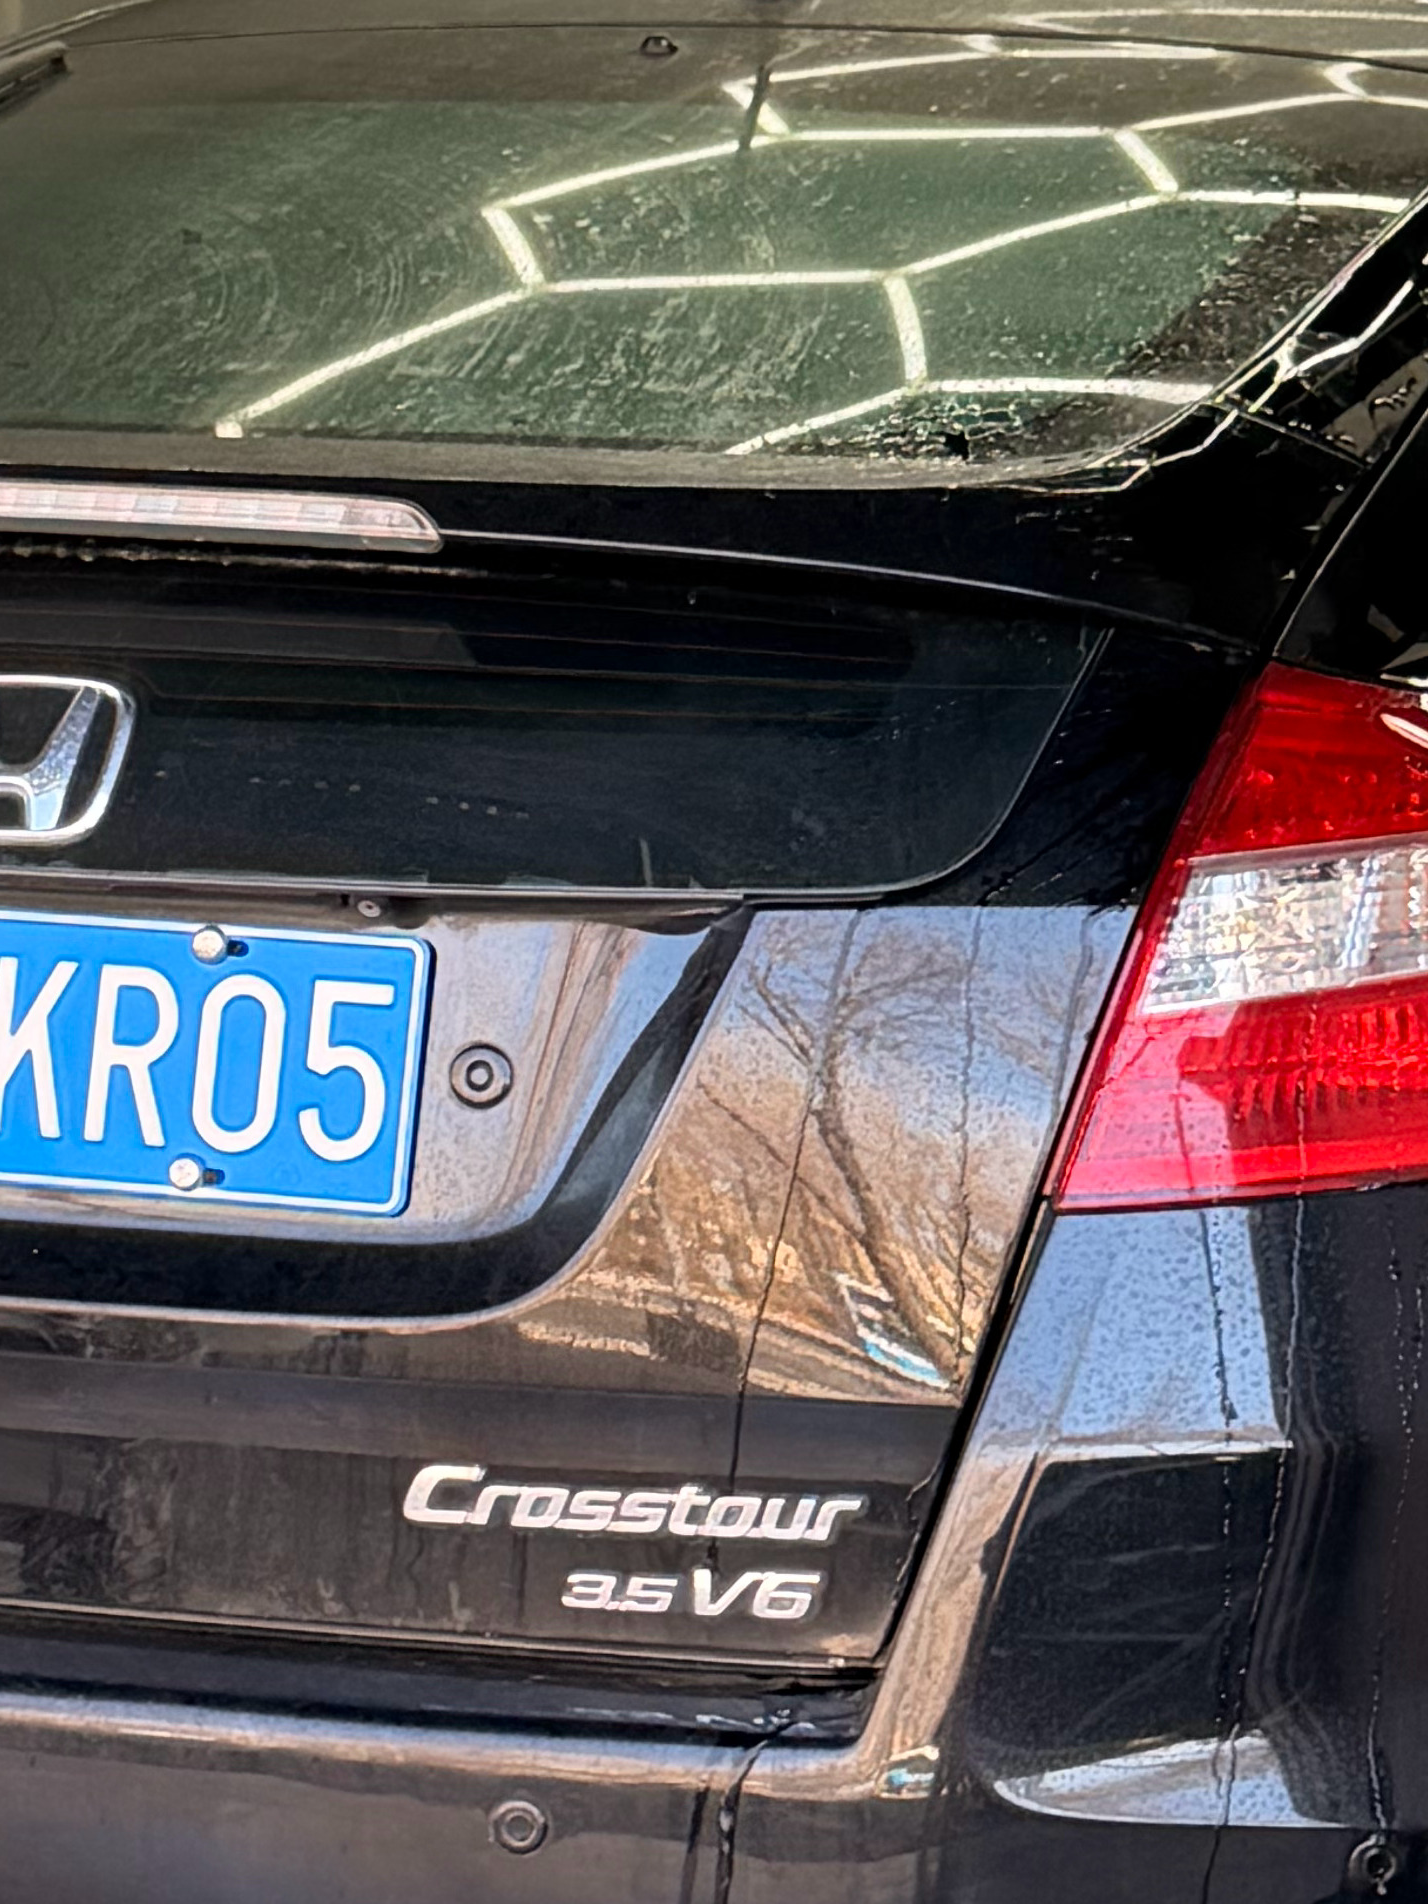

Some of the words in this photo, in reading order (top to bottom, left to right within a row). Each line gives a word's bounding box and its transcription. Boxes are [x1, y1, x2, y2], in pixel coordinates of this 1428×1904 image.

[402, 1464, 862, 1542] Crosstour
[561, 1572, 678, 1613] 3.5
[692, 1568, 821, 1620] V6
